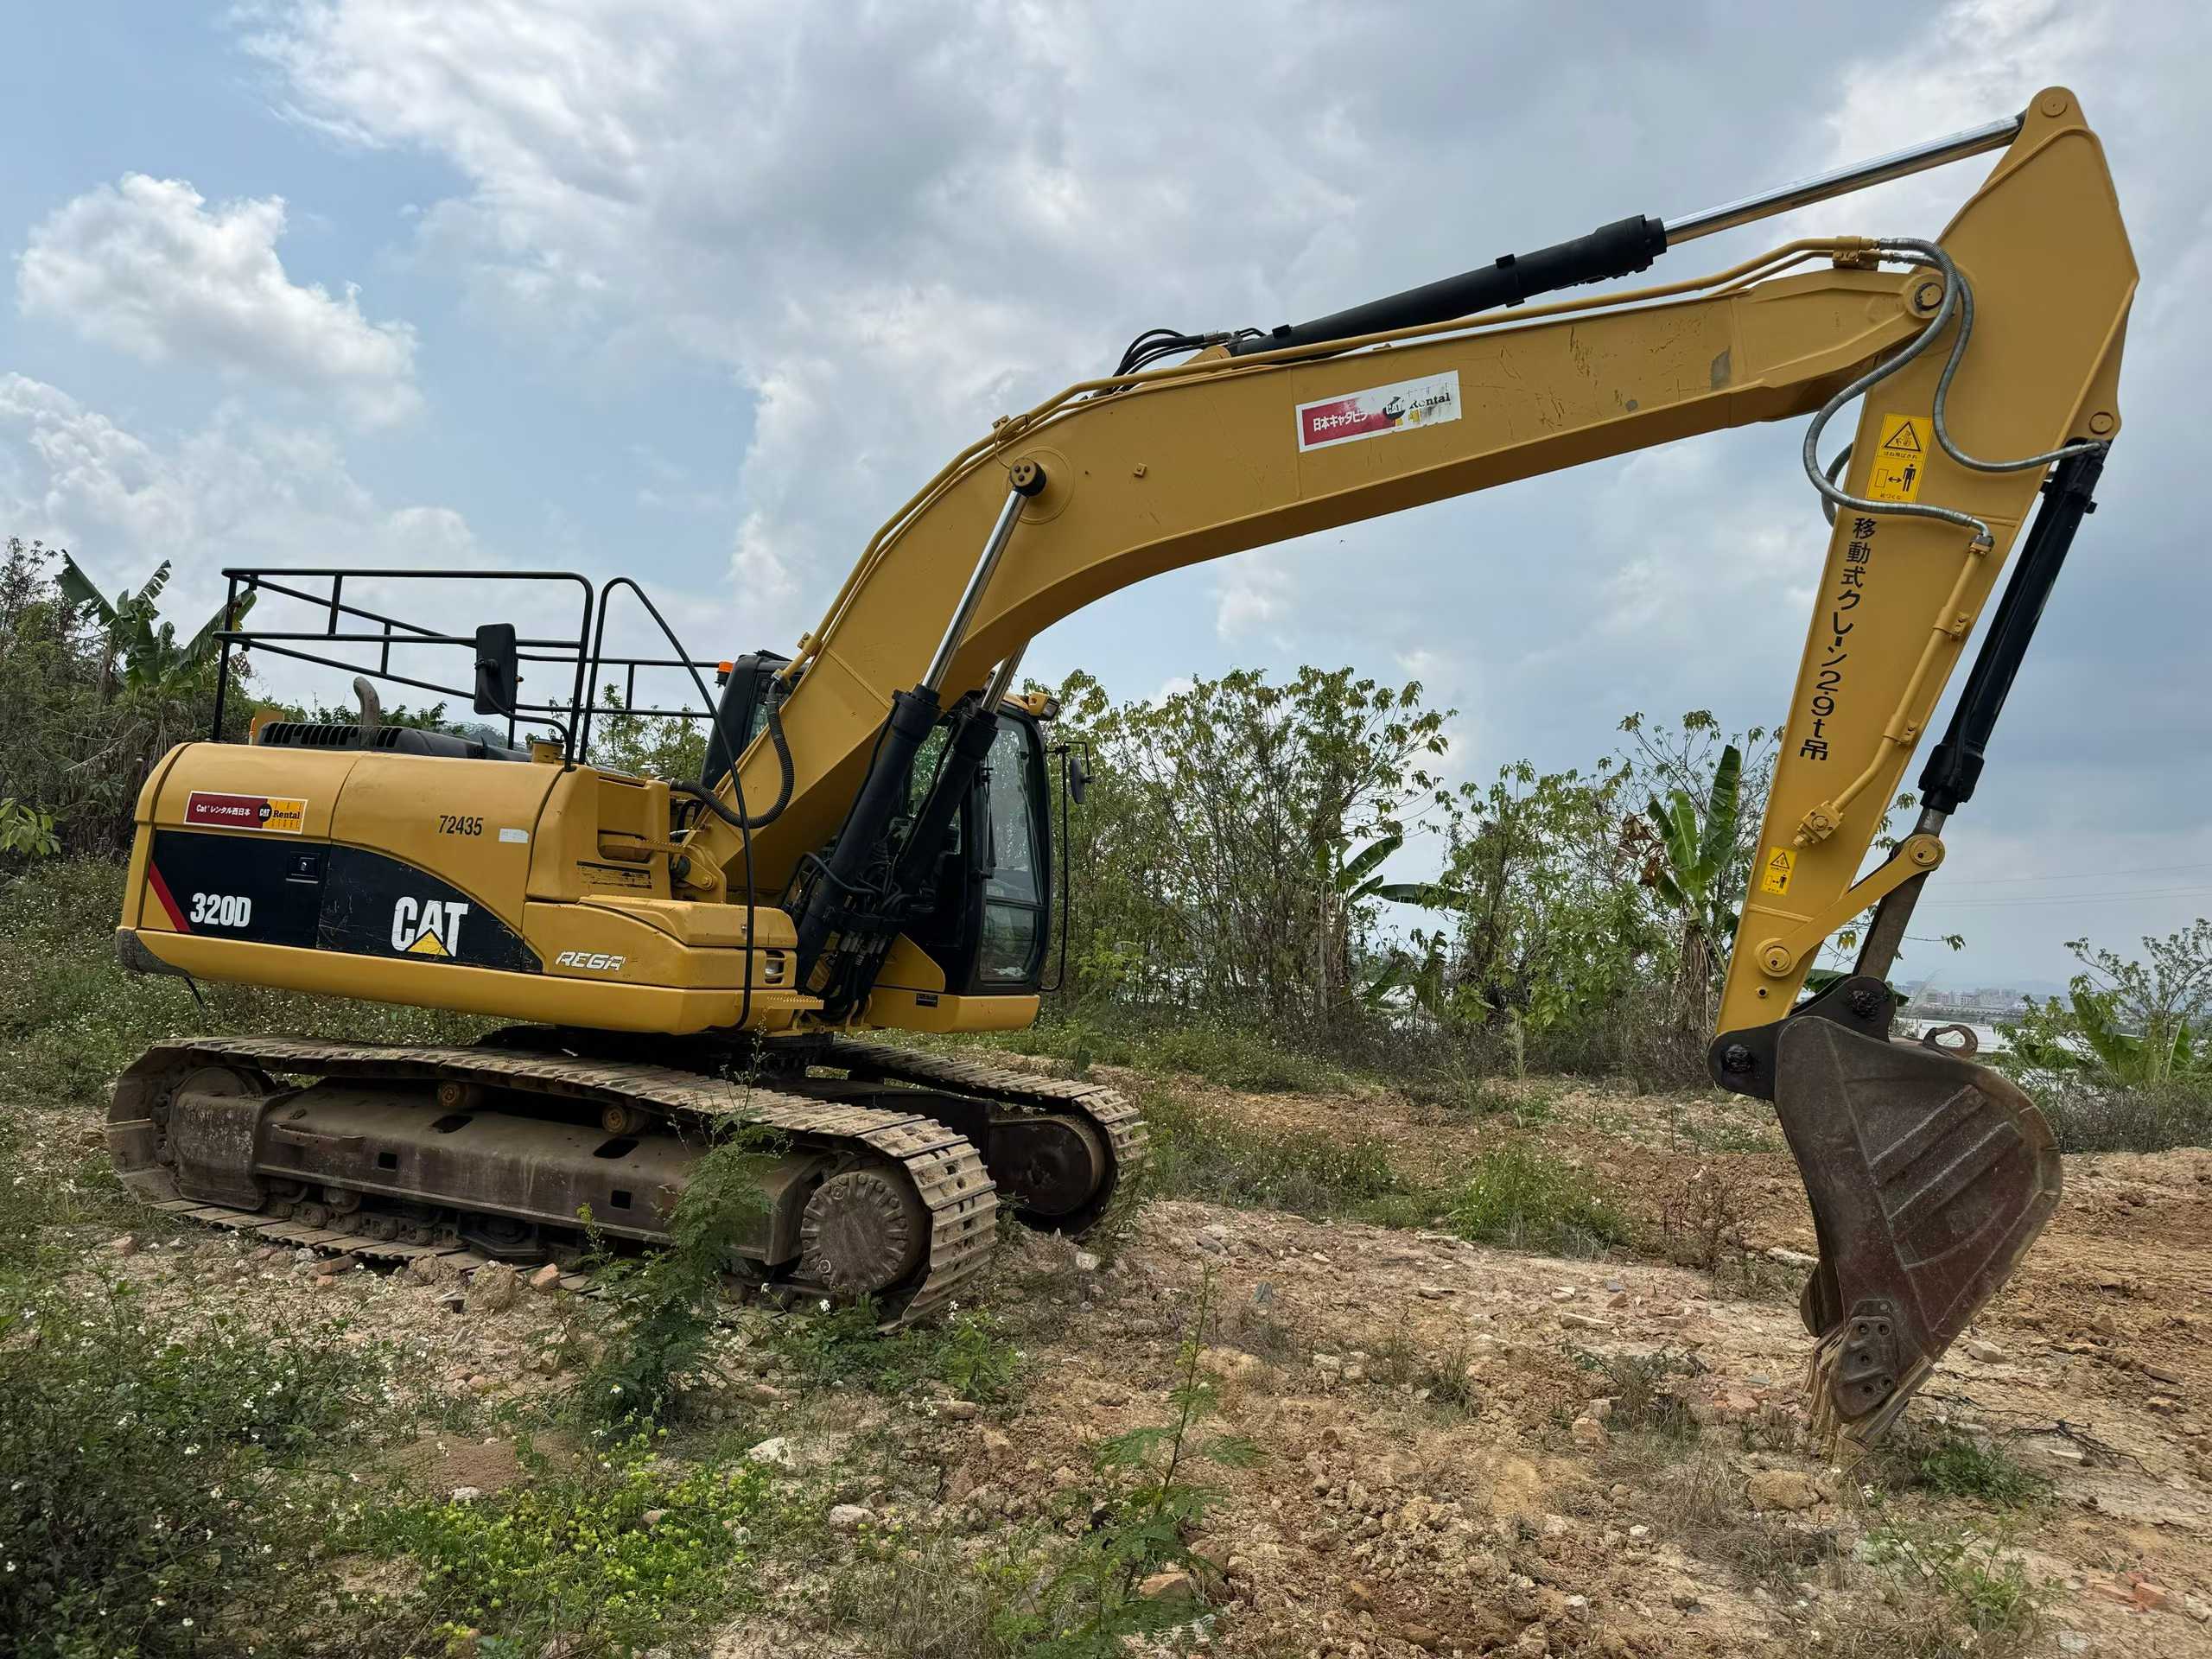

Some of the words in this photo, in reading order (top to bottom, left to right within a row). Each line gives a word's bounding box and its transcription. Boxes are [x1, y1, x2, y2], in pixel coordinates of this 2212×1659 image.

[259, 808, 270, 817] CAT
[273, 810, 300, 820] Rental
[438, 815, 484, 836] 72435
[189, 893, 252, 928] 320D
[391, 896, 469, 957] CAT
